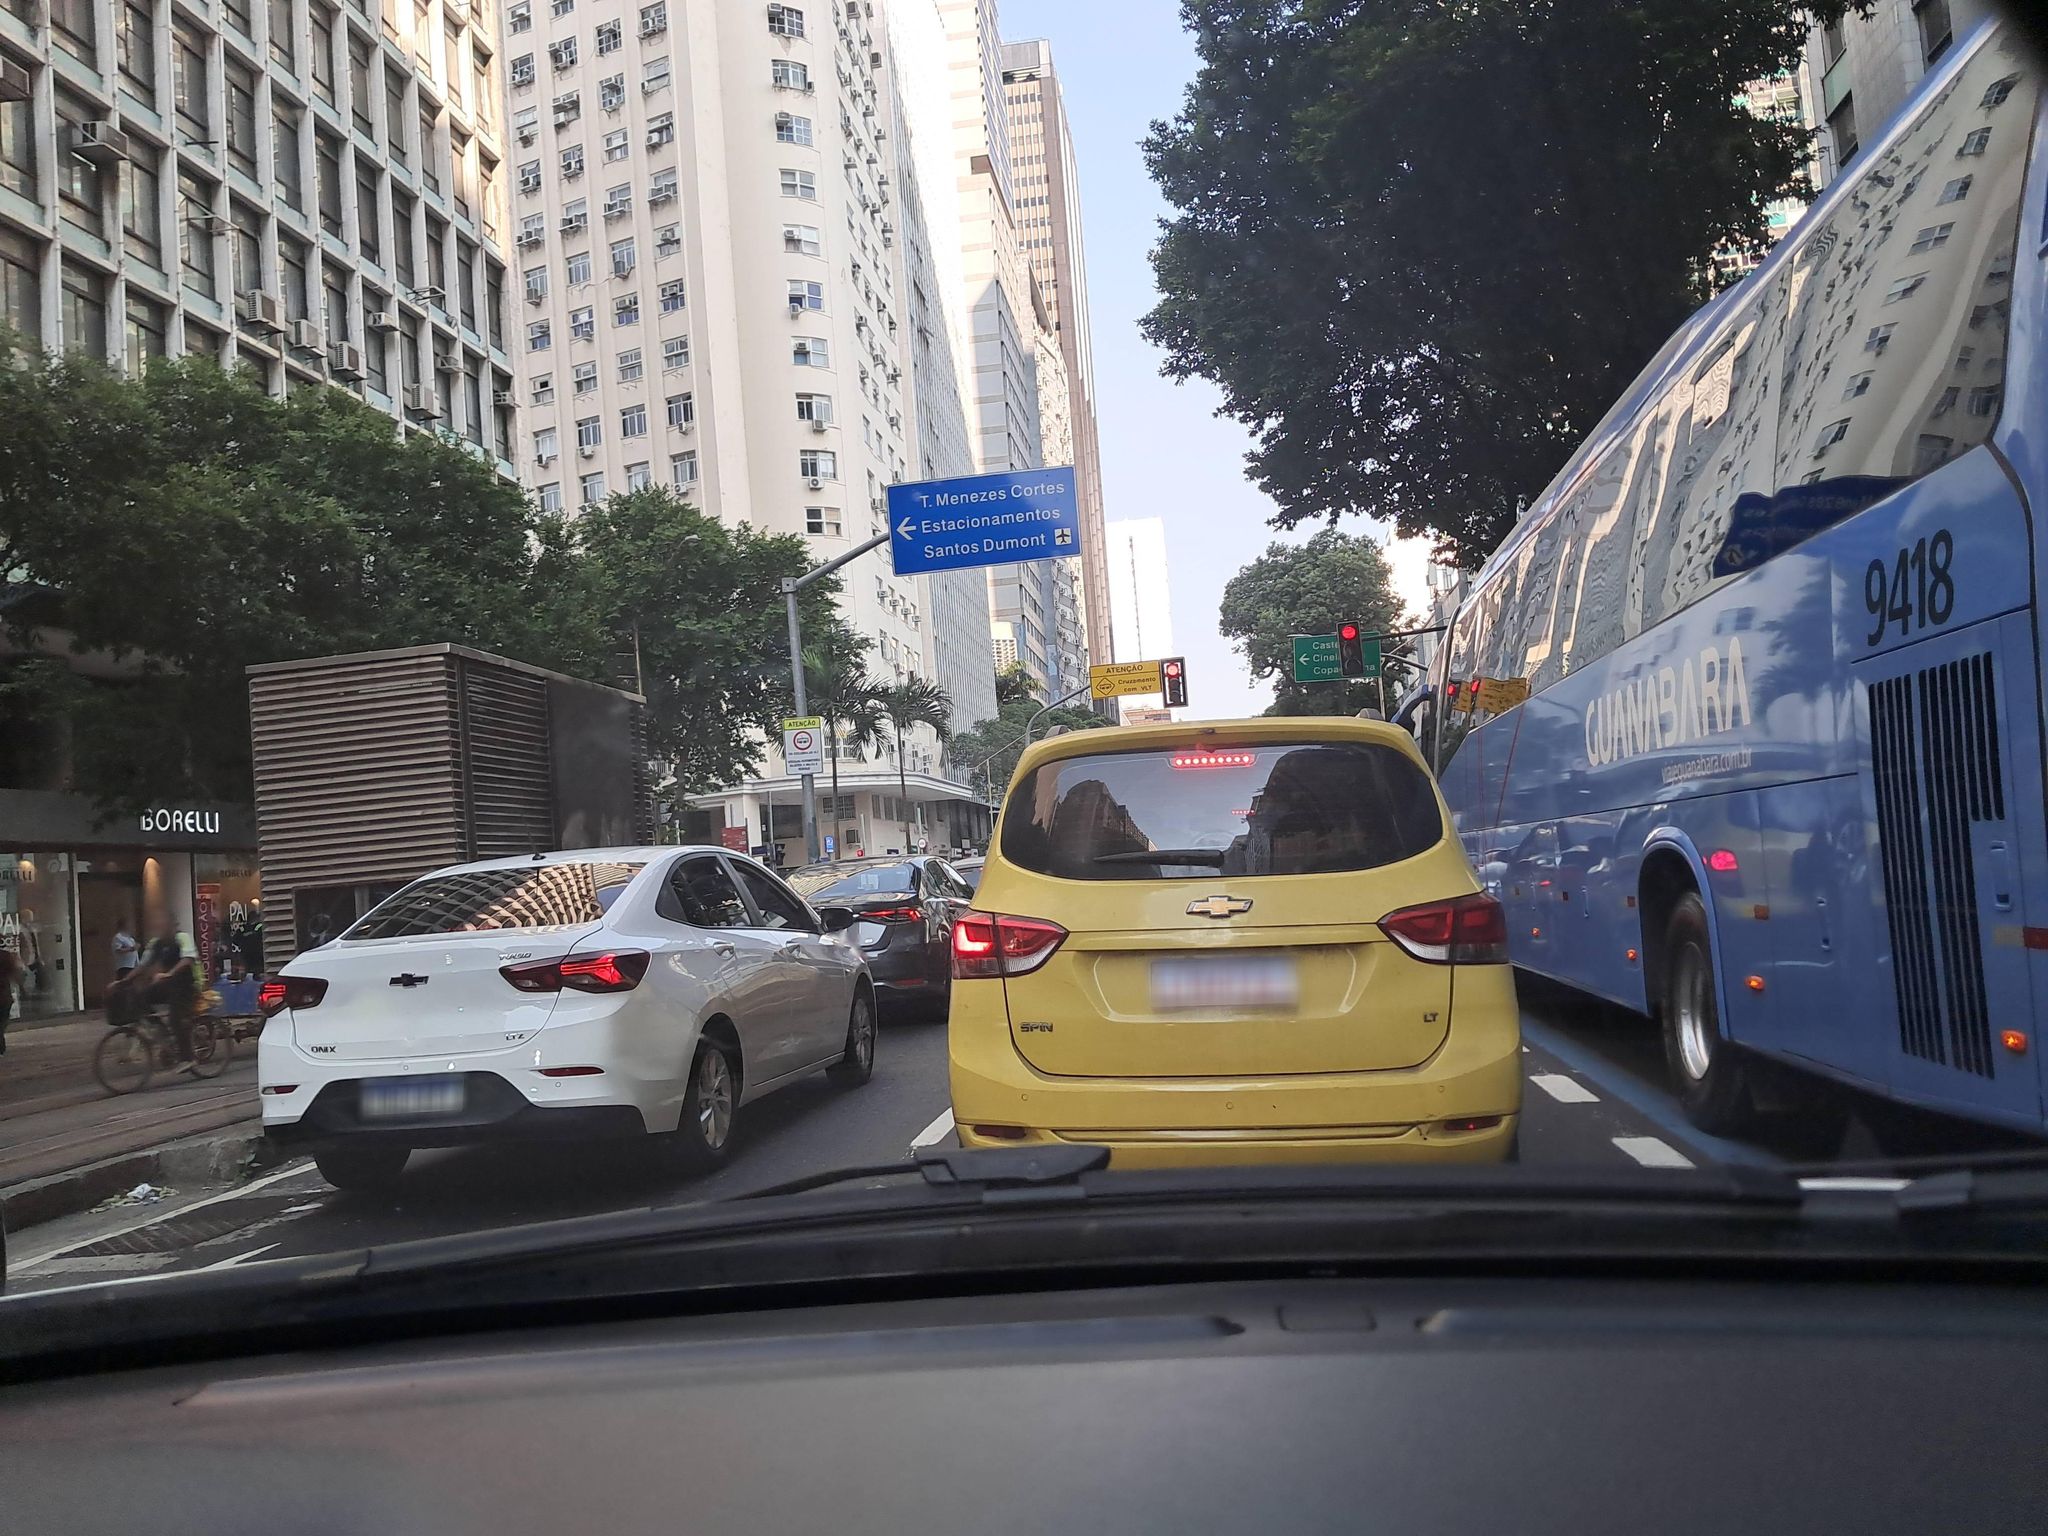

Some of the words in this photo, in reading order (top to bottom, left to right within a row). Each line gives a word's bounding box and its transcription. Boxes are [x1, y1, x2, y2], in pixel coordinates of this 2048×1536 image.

[920, 495, 932, 508] T.
[936, 487, 1007, 507] Menezes
[1010, 482, 1065, 498] Cortes
[921, 508, 1061, 534] Estacionamentos
[924, 541, 979, 559] Santos
[983, 533, 1046, 552] Dumont
[1864, 529, 1955, 647] 9418
[1106, 664, 1144, 674] ATENÇÃO
[1117, 677, 1157, 685] Cruzamento
[1585, 636, 1751, 767] GUANABARA
[788, 720, 816, 728] ATENÇÃO
[140, 808, 219, 833] BORELLI
[229, 903, 248, 921] PAI
[1423, 1011, 1439, 1023] LT
[1020, 1022, 1054, 1033] SPIN
[505, 1033, 526, 1041] LTZ
[311, 1045, 337, 1054] ONIX
